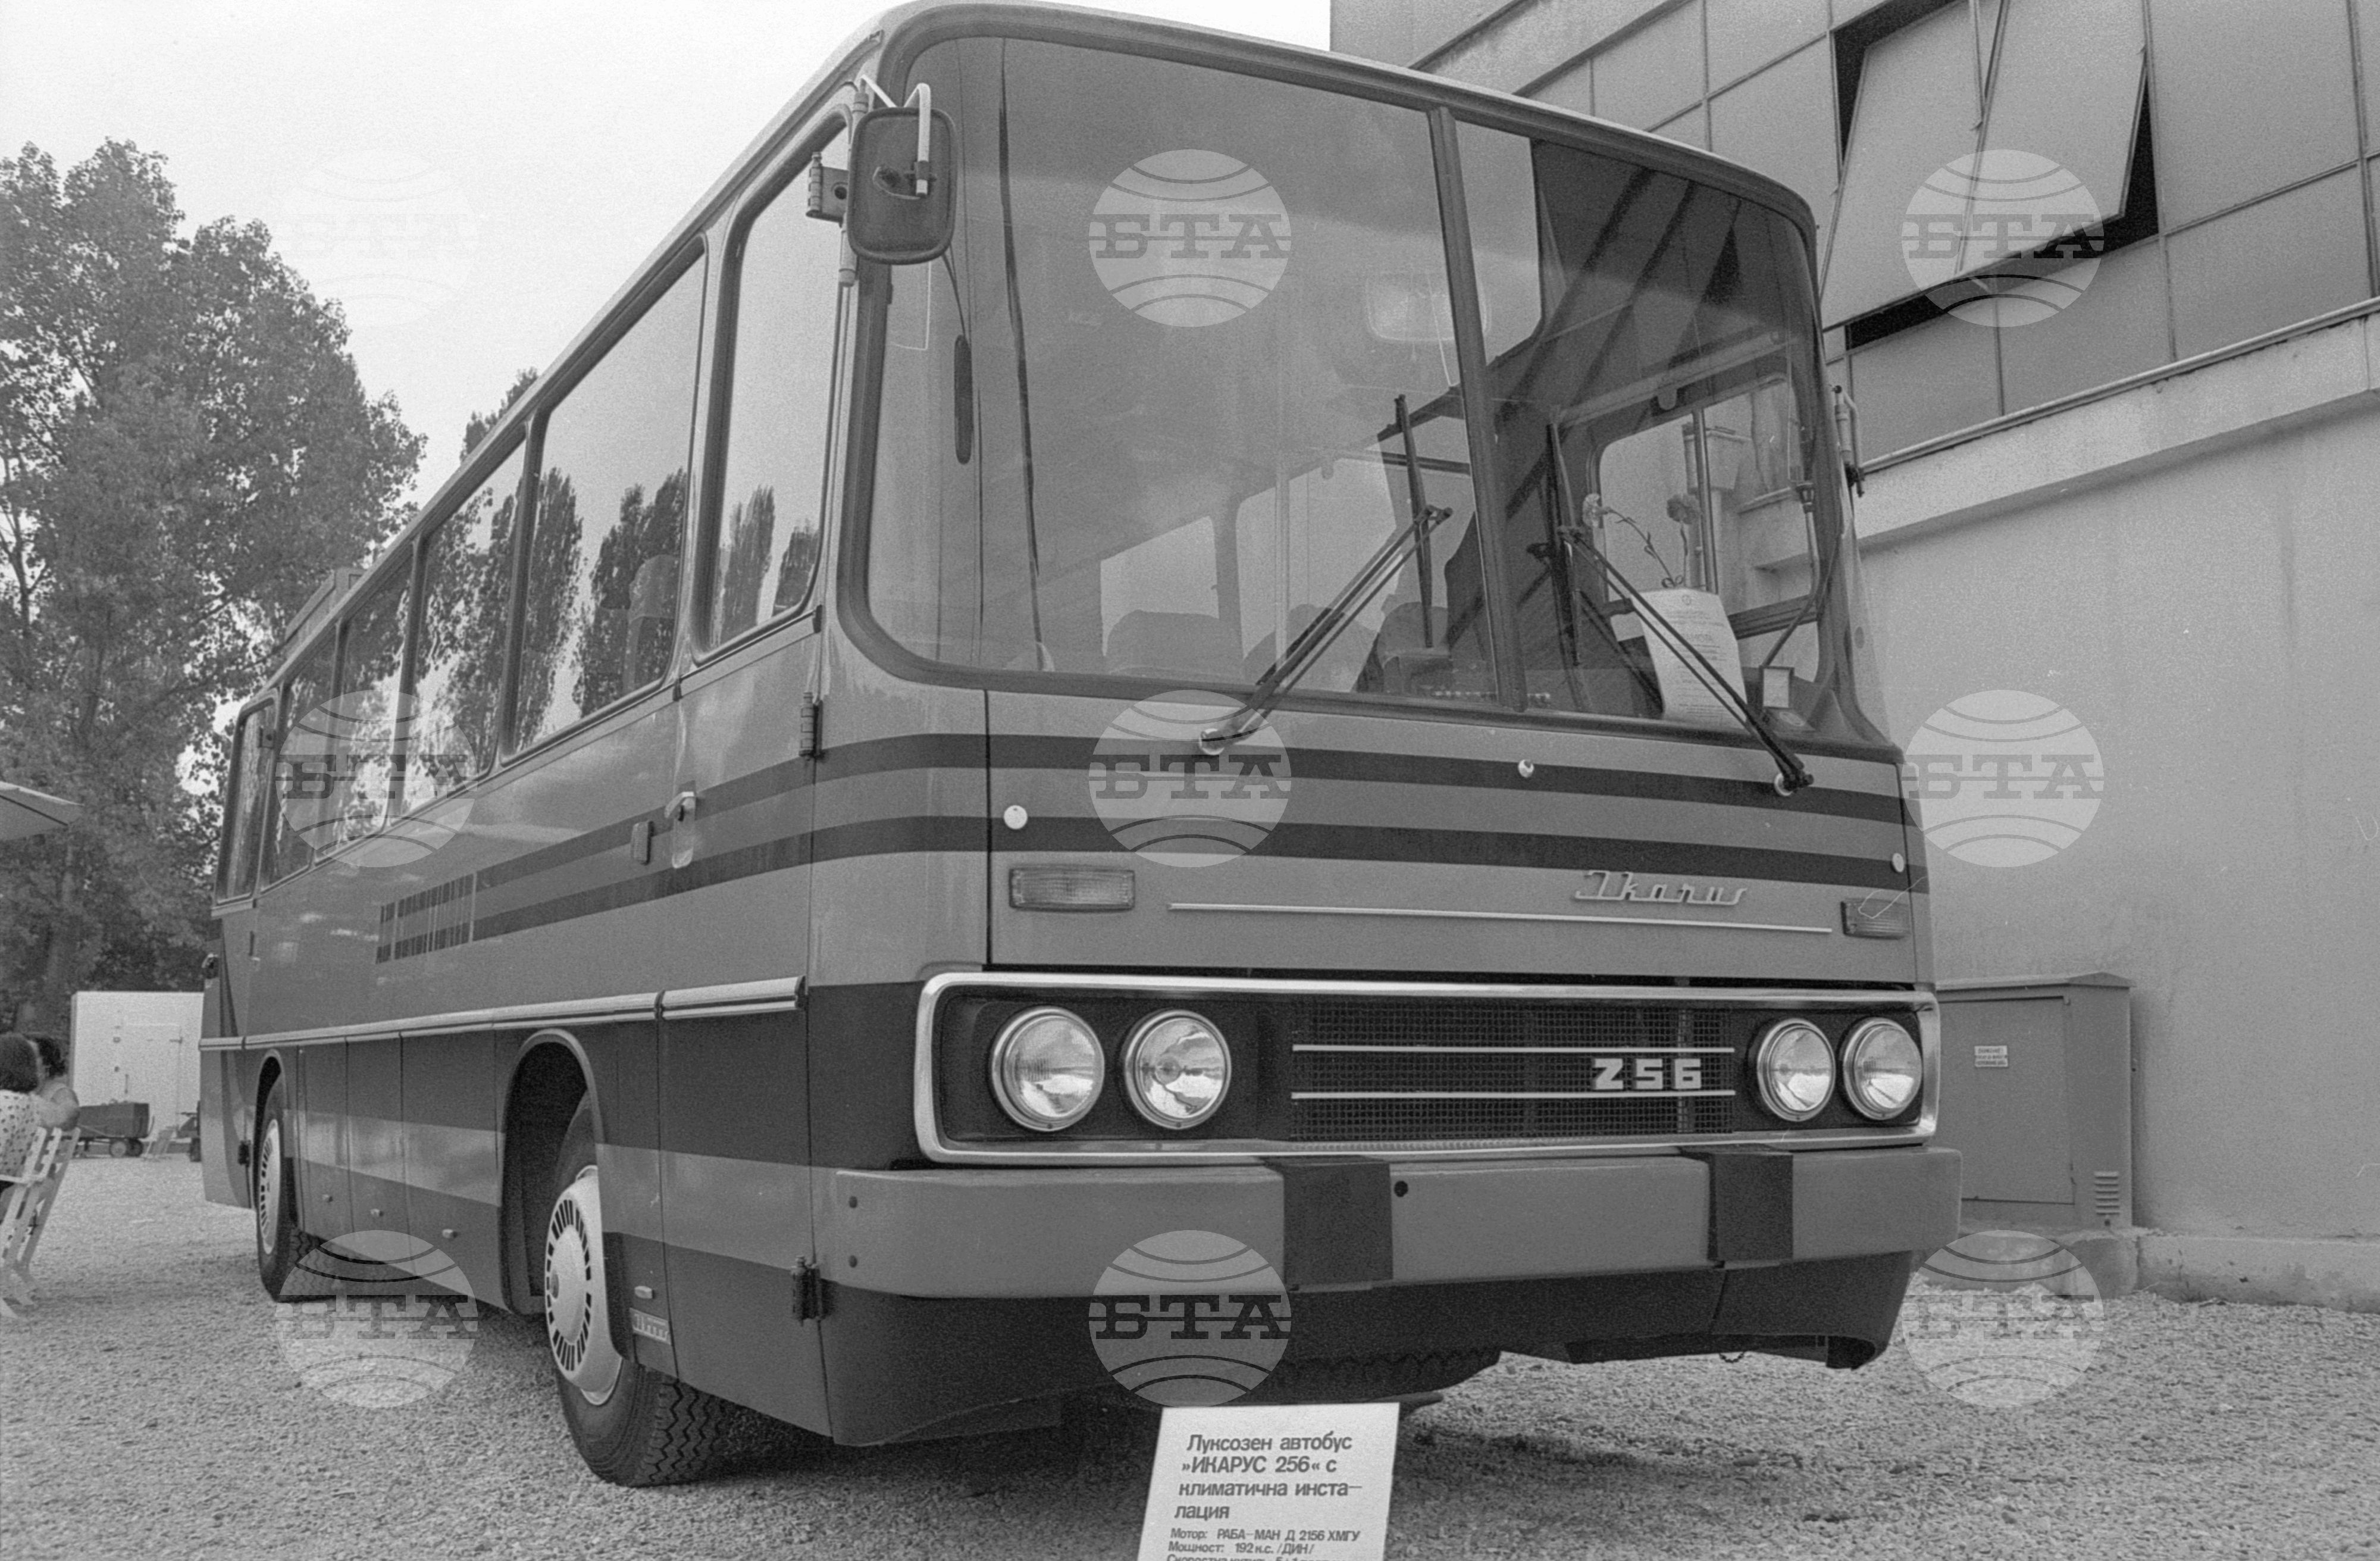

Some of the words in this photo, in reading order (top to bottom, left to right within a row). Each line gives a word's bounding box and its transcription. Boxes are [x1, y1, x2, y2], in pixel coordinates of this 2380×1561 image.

[1574, 871, 1747, 906] Ikarus
[1592, 1058, 1701, 1090] 256
[1186, 1434, 1272, 1454] Луксозен
[1279, 1431, 1352, 1453] автобус
[1182, 1456, 1267, 1473] »ИКАРУС
[1326, 1459, 1337, 1473] с
[1179, 1482, 1288, 1496] климатична
[1175, 1506, 1230, 1521] лация
[1170, 1528, 1208, 1540] Мотор:
[1285, 1529, 1295, 1542] Д
[1299, 1530, 1325, 1541] 2156
[1327, 1530, 1361, 1541] ХМГУ
[1168, 1541, 1225, 1553] Мощност:
